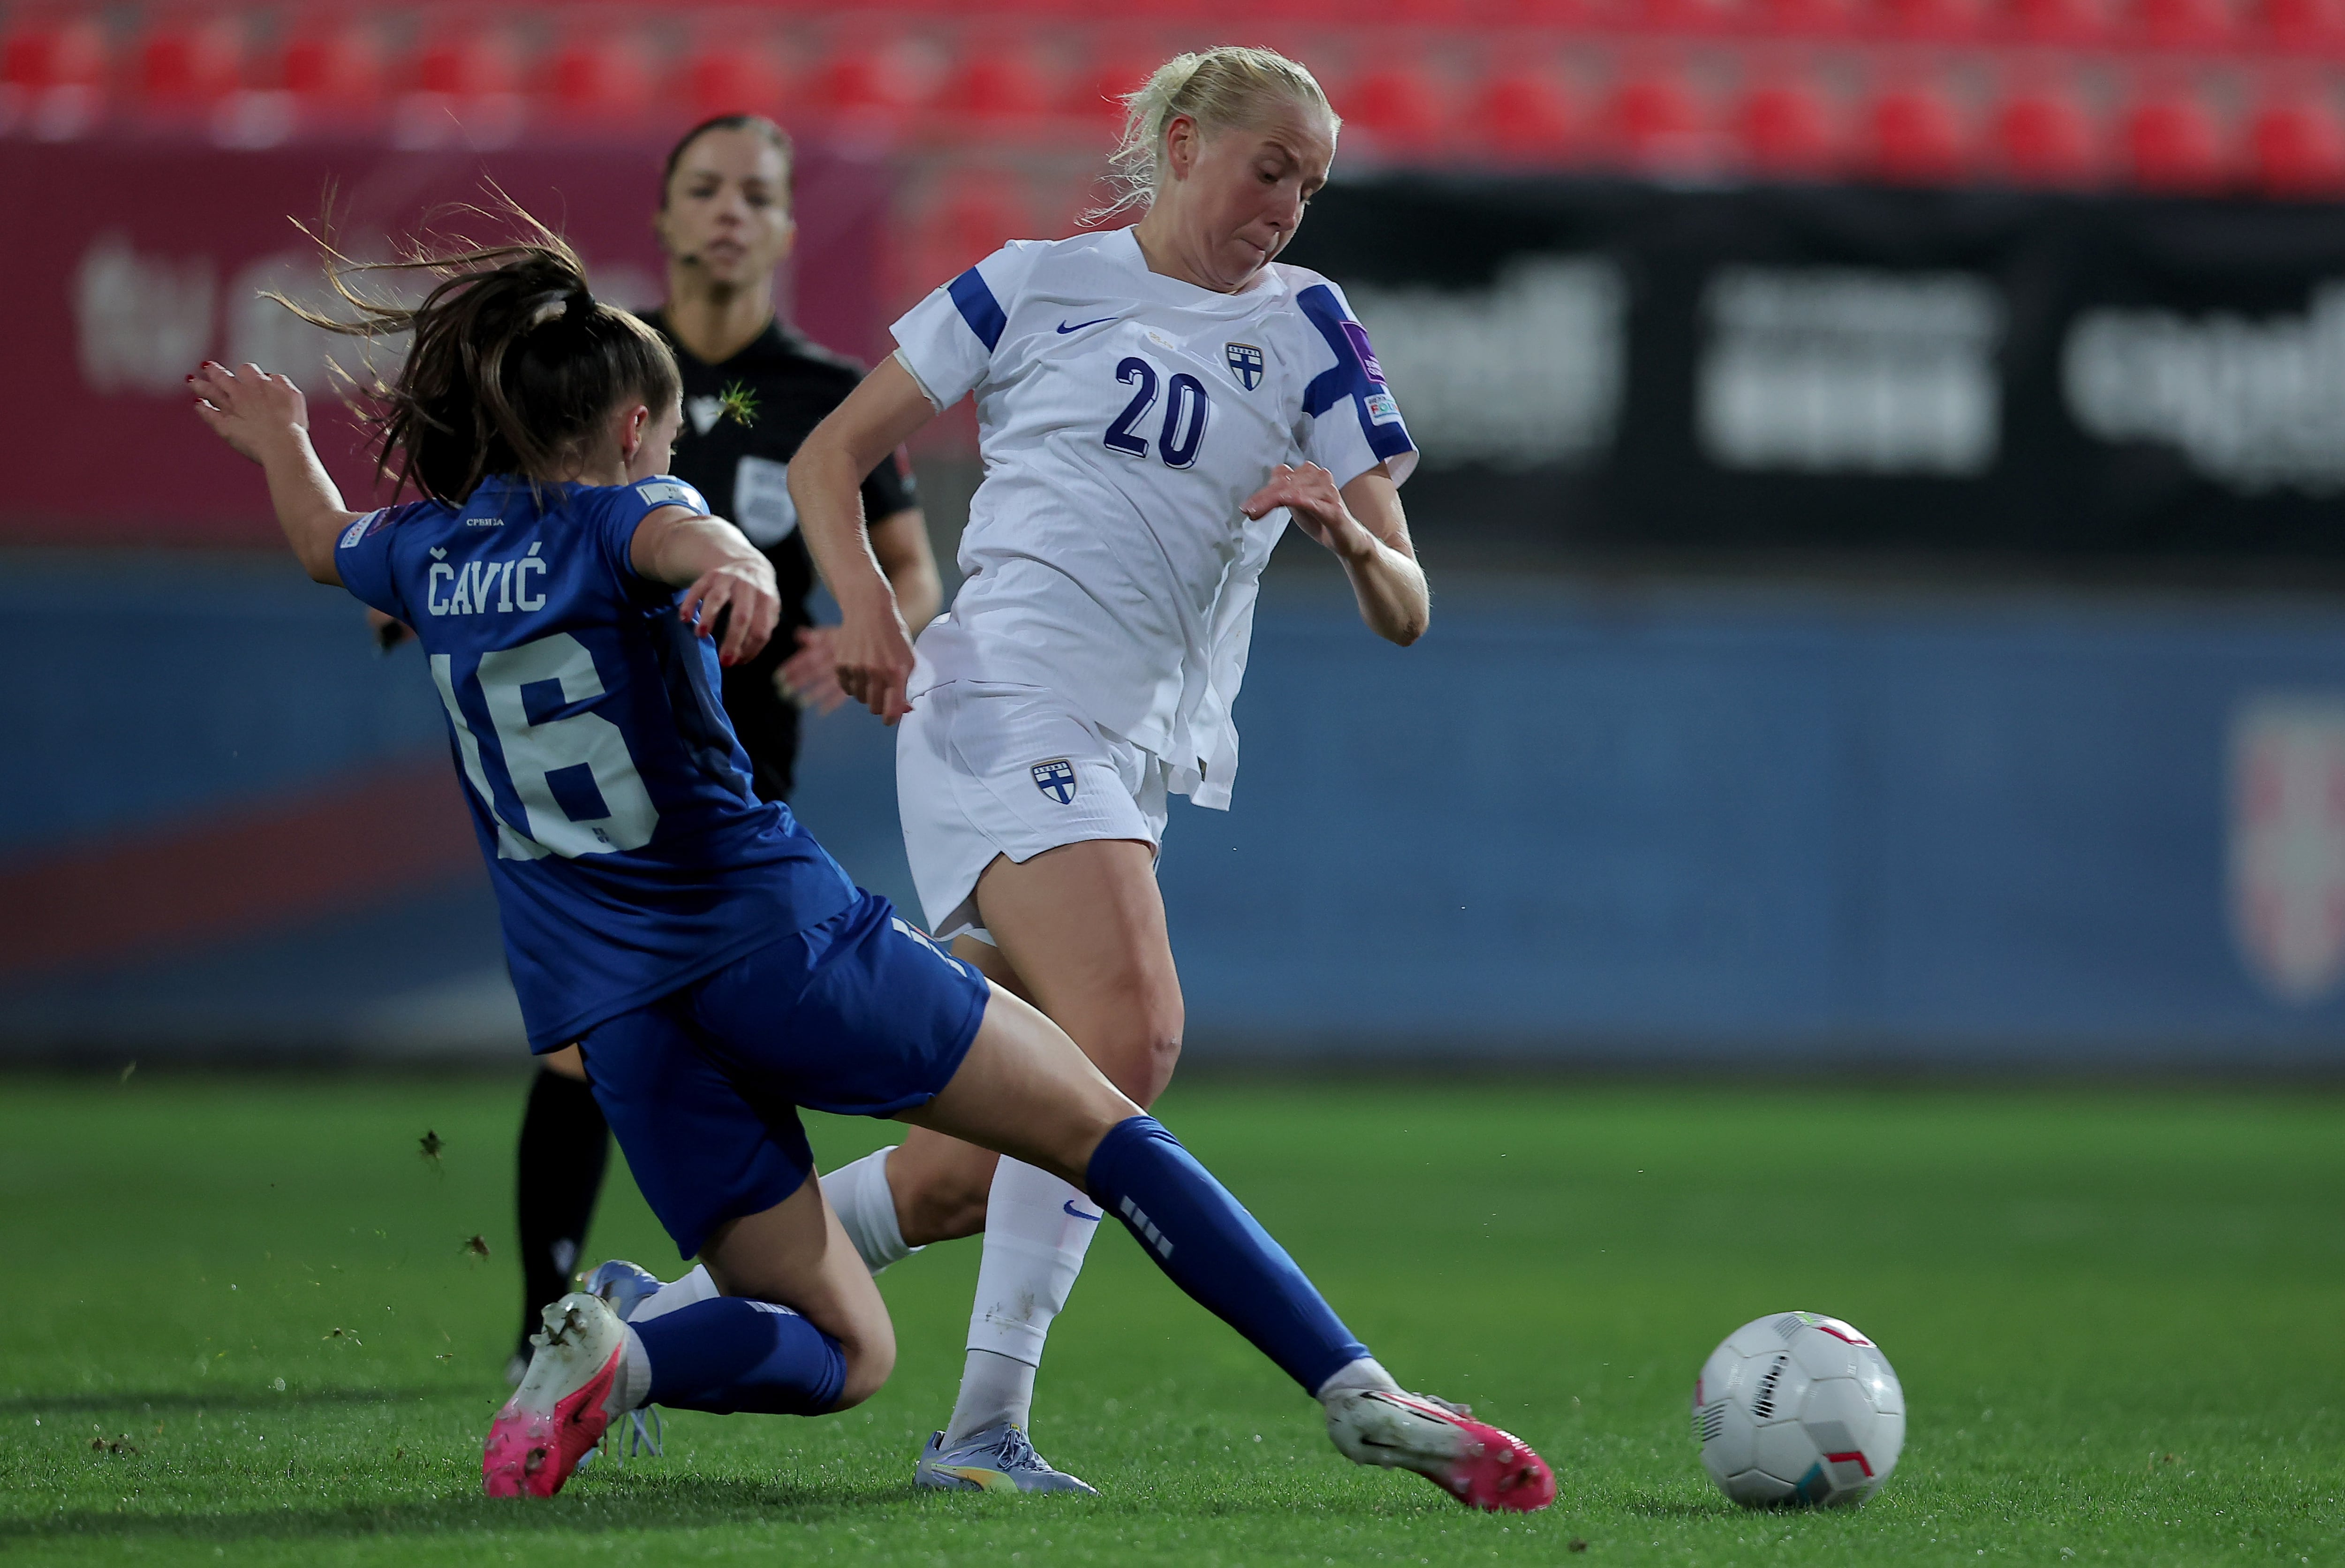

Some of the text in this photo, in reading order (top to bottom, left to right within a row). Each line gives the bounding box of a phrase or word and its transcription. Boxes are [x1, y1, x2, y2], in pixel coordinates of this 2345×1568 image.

[1104, 356, 1210, 470] 20
[428, 542, 546, 616] ČAVIĆ
[430, 632, 660, 861] 16
